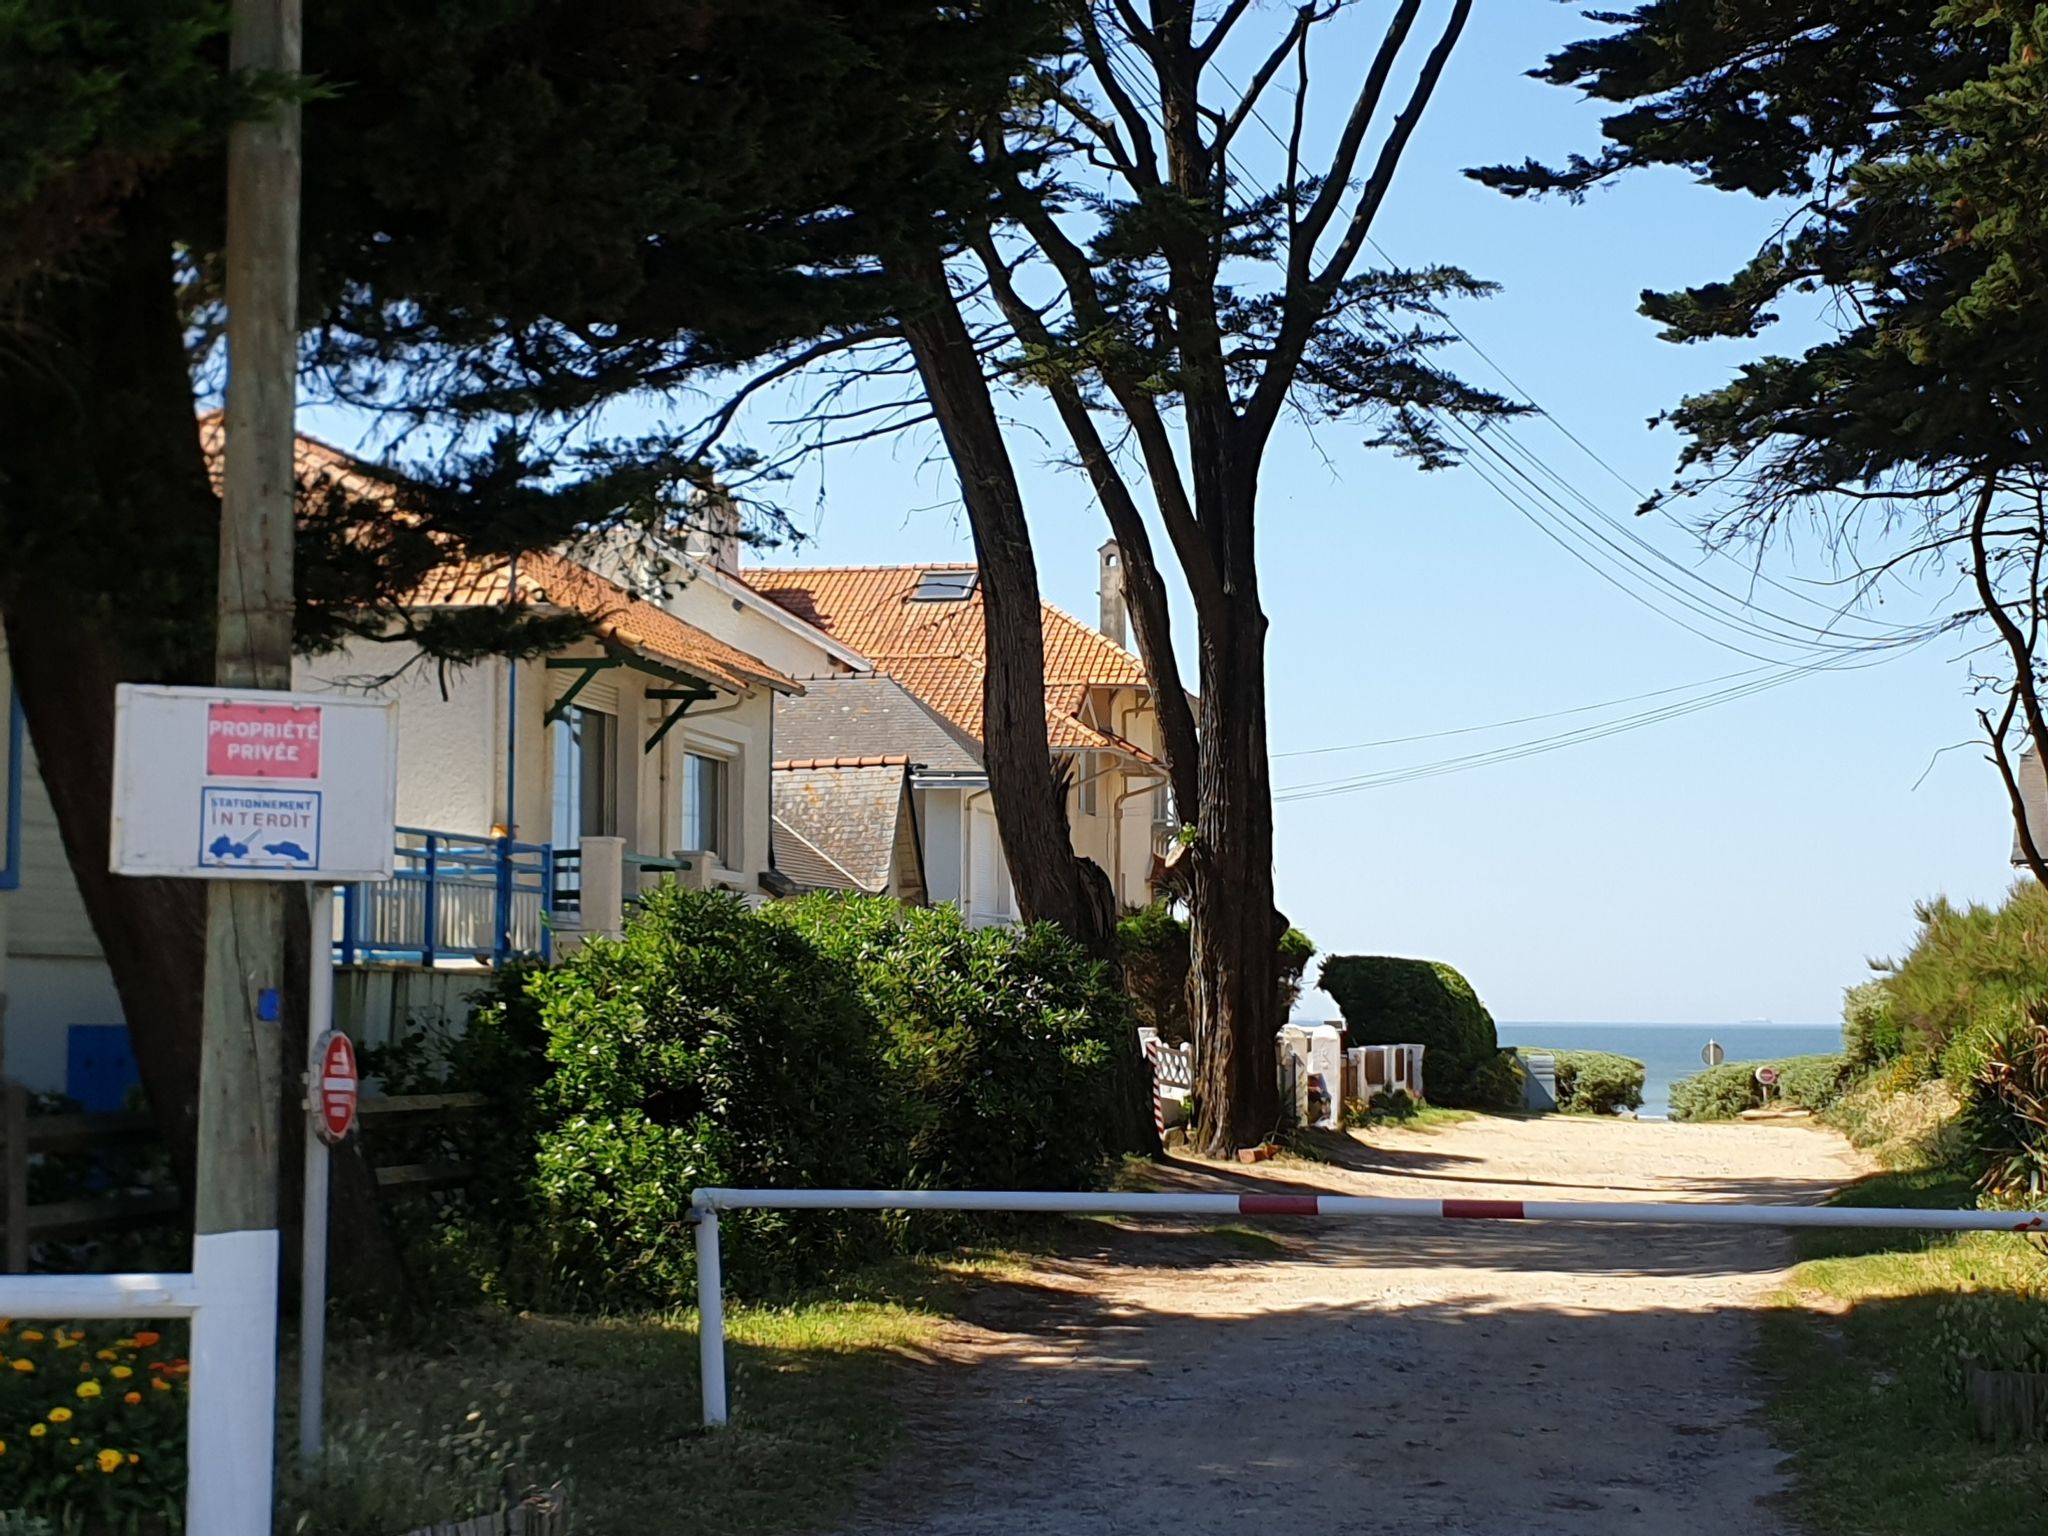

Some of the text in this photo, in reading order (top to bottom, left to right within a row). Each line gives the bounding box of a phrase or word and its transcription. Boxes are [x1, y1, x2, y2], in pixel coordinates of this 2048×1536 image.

[209, 720, 319, 739] PROPRIÉTÉ
[227, 743, 299, 761] PRIVÉE
[211, 798, 312, 811] STATIONNEMENT
[211, 809, 311, 828] INTERDIT
